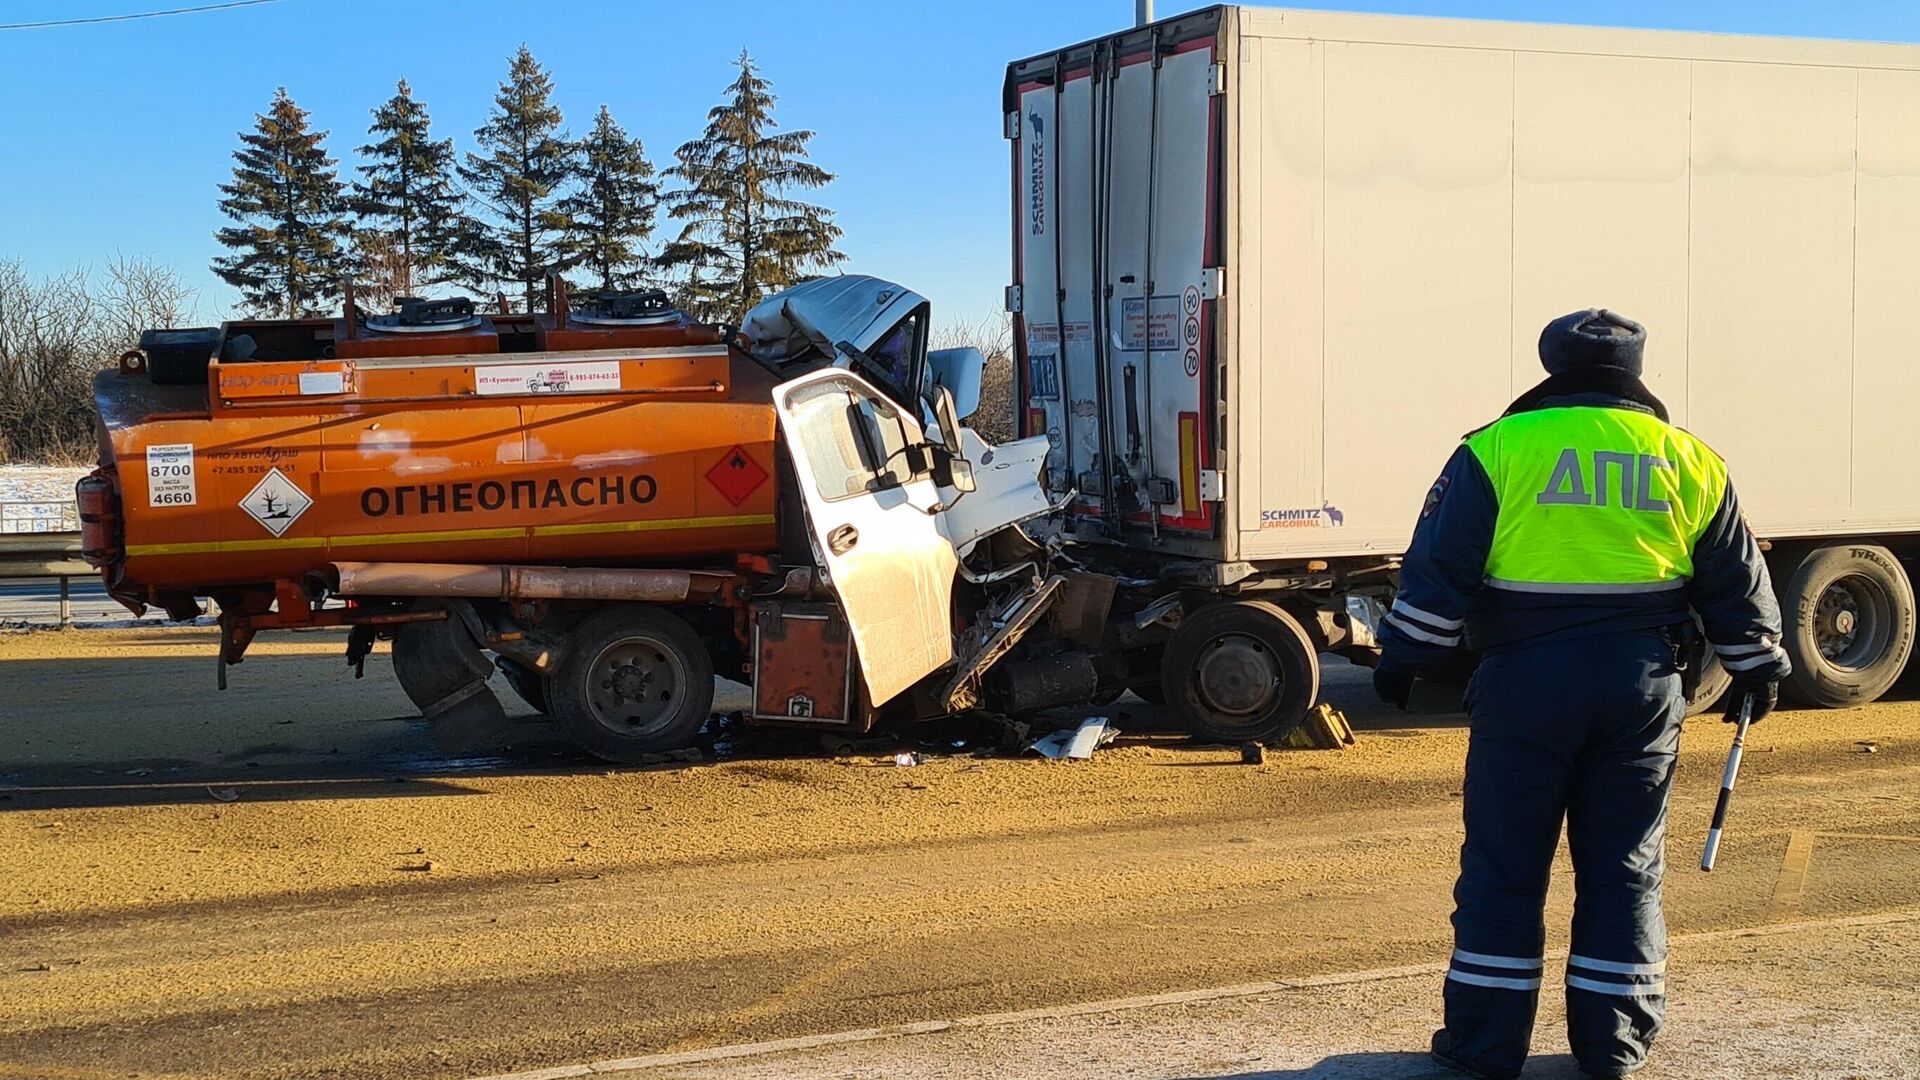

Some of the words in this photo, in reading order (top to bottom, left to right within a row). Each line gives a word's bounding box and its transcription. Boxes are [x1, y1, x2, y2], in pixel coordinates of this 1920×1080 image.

[1032, 143, 1040, 236] SCHMITZ
[1186, 294, 1196, 309] 90
[1187, 325, 1196, 338] 80
[1187, 356, 1197, 369] 70
[207, 451, 230, 460] НПО
[151, 465, 191, 477] 8700
[247, 464, 296, 473] 926--51
[1537, 448, 1675, 513] ДПС
[153, 492, 192, 504] 4660
[360, 474, 657, 517] ОГНЕОПАСНО
[1262, 509, 1320, 520] SCHMITZ
[1262, 519, 1320, 528] CARGOBULL
